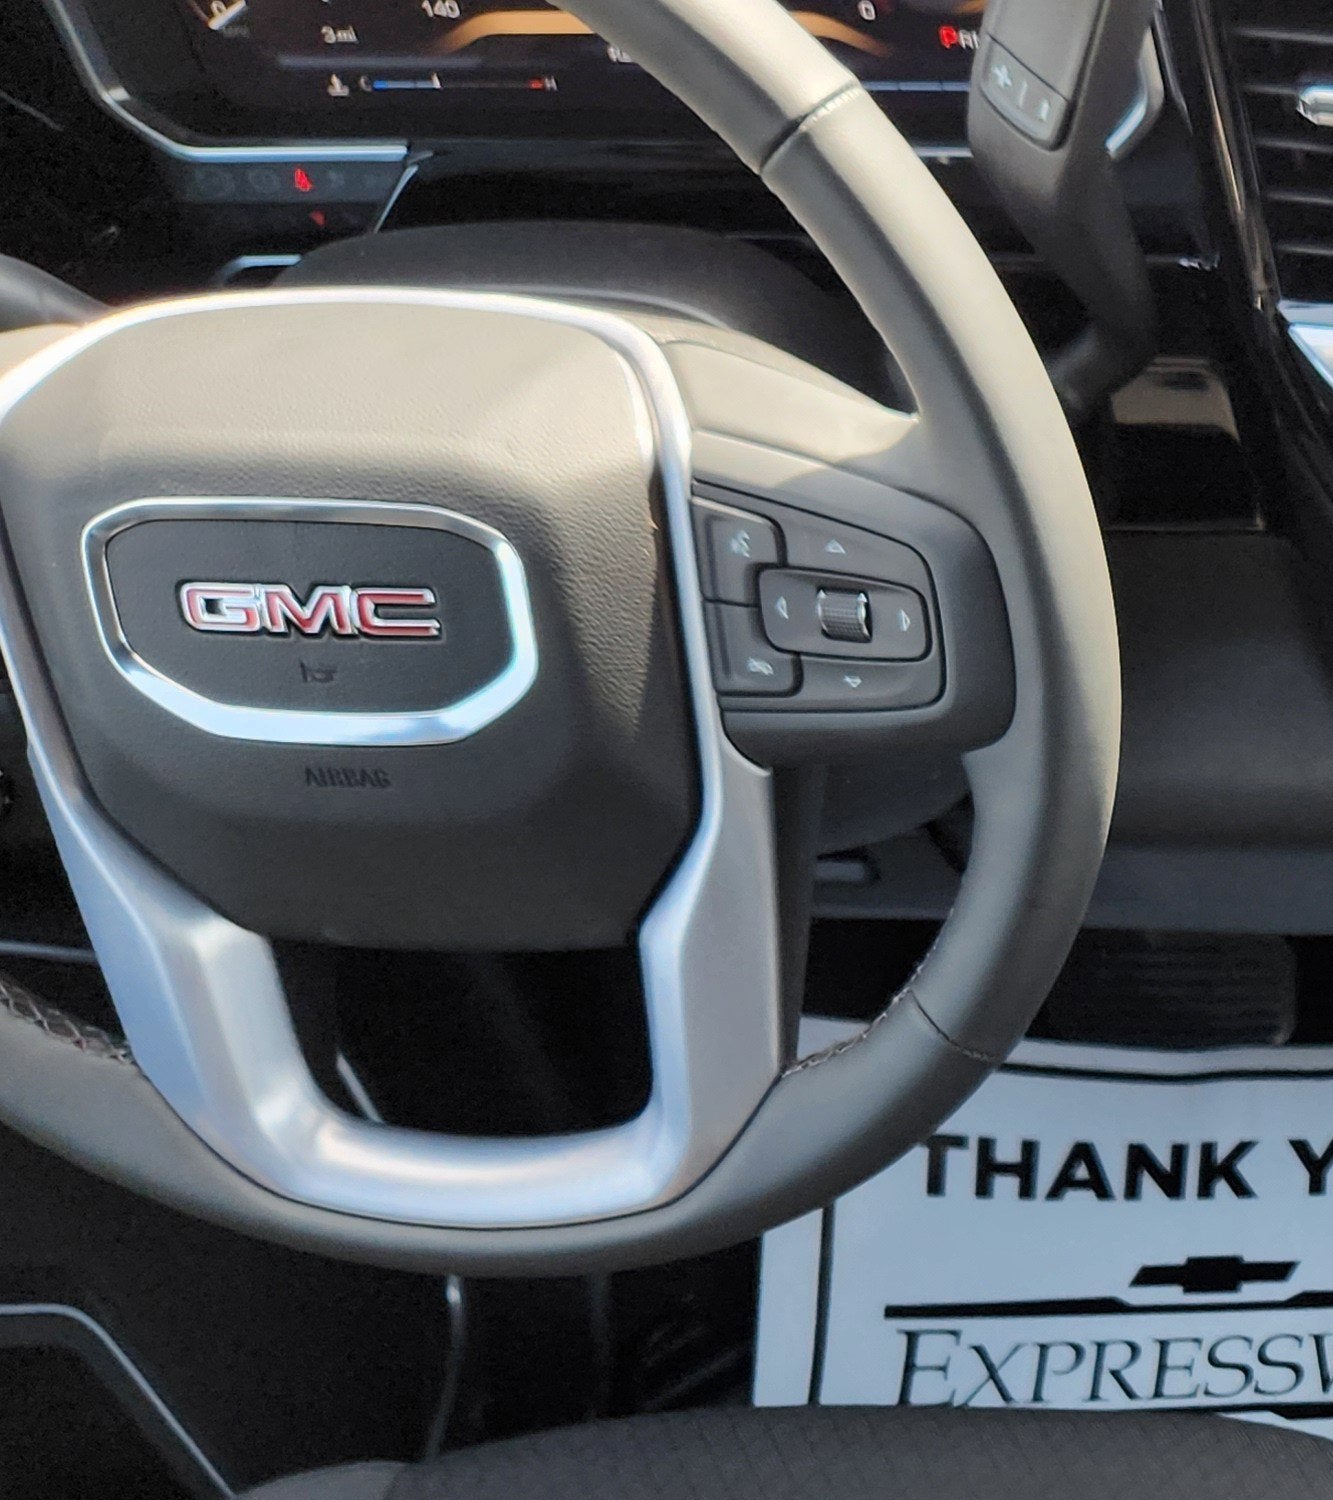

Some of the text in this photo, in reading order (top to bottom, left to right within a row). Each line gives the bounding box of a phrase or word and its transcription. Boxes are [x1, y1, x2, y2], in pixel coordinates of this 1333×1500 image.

[421, 0, 461, 19] 140
[180, 581, 440, 638] GMC
[304, 766, 391, 789] AIRBAG
[914, 1133, 1259, 1202] THANK
